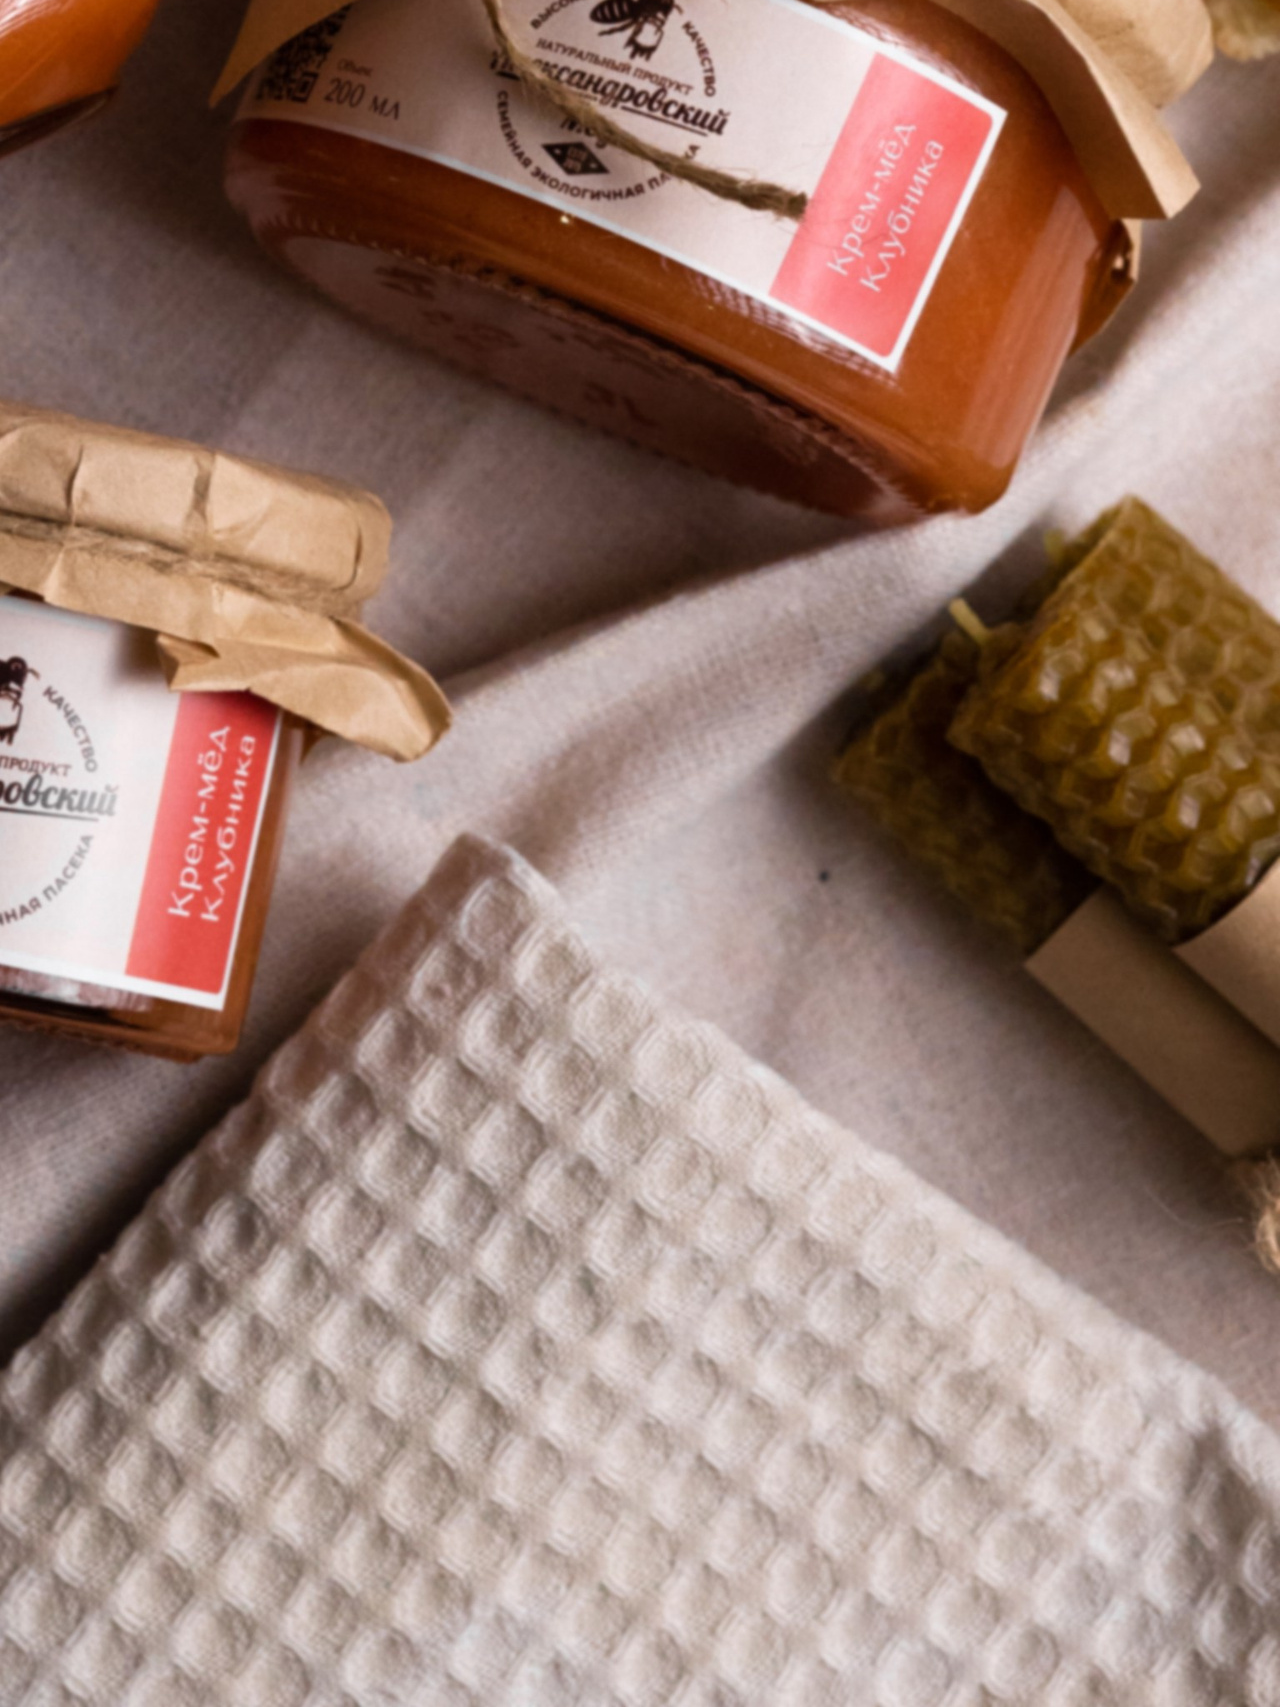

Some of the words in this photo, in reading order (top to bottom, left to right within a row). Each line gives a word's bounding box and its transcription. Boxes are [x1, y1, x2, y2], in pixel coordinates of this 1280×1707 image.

[324, 77, 365, 108] 200
[370, 96, 400, 120] мл
[490, 50, 730, 136] ксандровский
[536, 38, 632, 75] НАТУРАЛЬНЫЙ
[633, 67, 694, 96] ПРОДУКТ
[682, 21, 716, 98] КАЧЕСТВО
[497, 90, 532, 168] СЕМЕЙНАЯ
[531, 166, 646, 201] ЭКОЛОГИЧНАЯ
[826, 124, 916, 275] Крем-мёд
[860, 140, 944, 292] Клубника
[43, 686, 98, 773] КАЧЕСТВО
[168, 725, 231, 918] Крем-мёд
[200, 735, 256, 922] Клубника
[42, 834, 94, 902] ПАСЕКА
